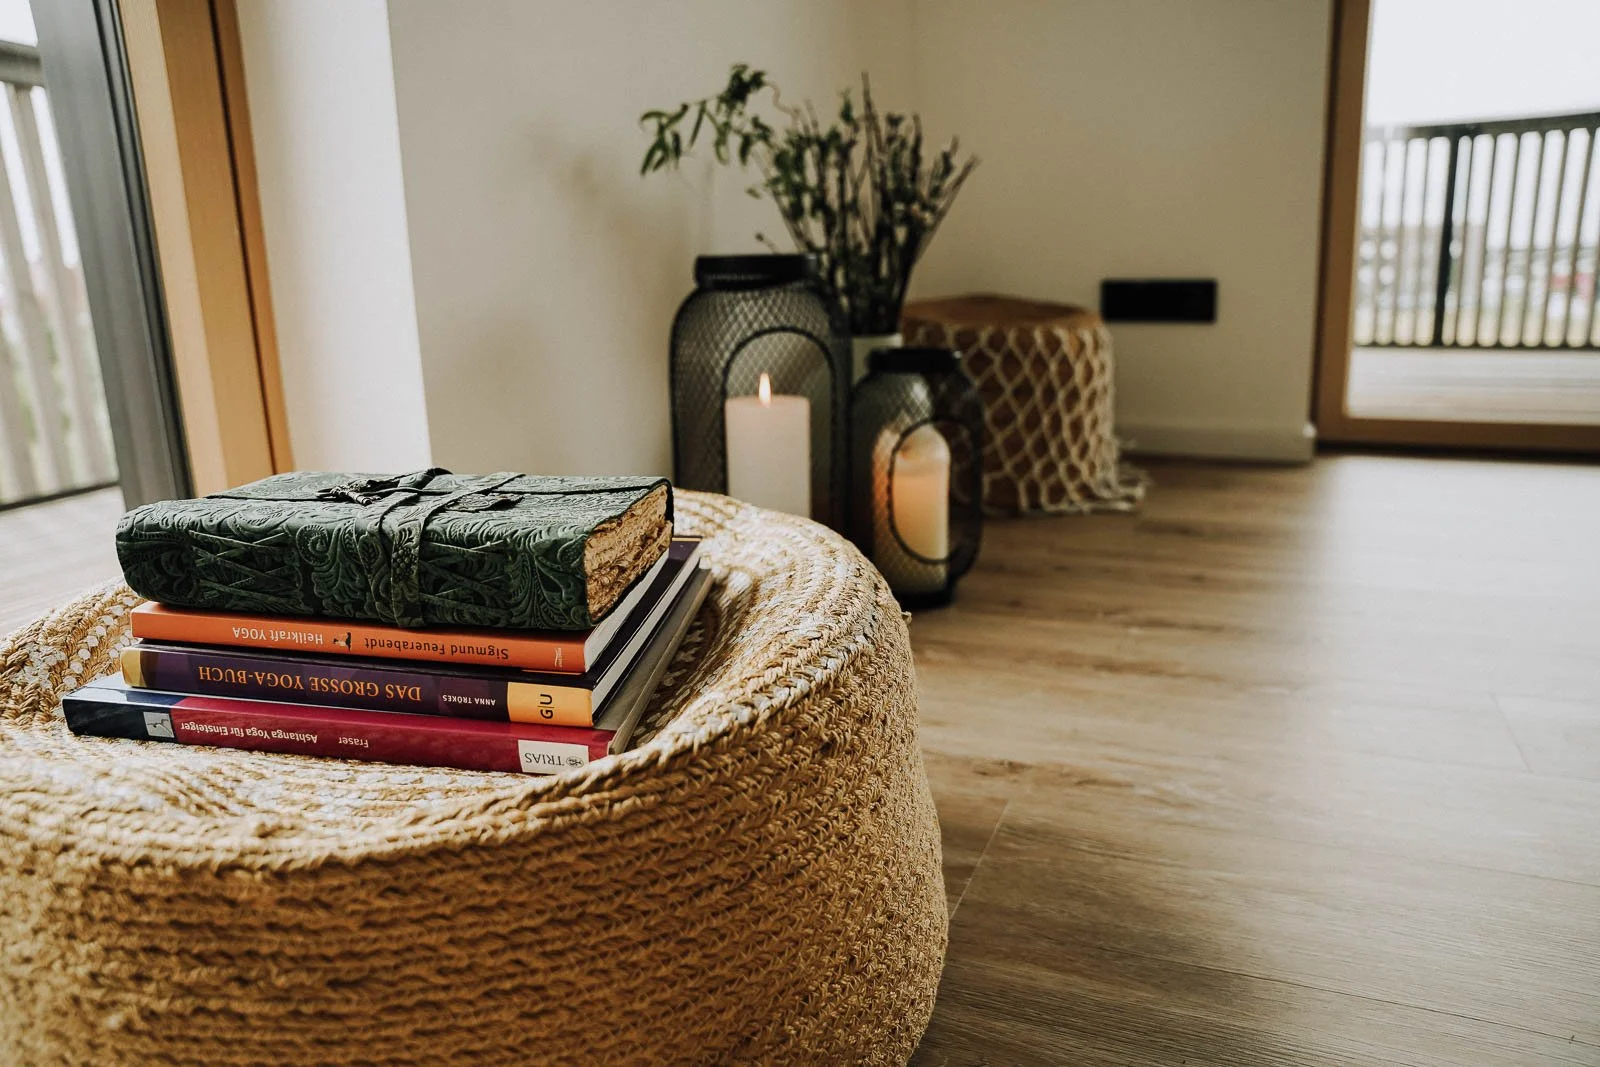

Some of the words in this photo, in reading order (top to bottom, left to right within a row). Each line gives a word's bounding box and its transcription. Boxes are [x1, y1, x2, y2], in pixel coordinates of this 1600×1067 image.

[232, 627, 265, 641] YOGA
[269, 629, 324, 645] Heilkraft
[364, 637, 446, 655] Feuerabendt
[450, 643, 509, 660] Sigmund
[198, 666, 305, 690] YOGA-BUCH
[310, 677, 379, 697] GROSSE
[385, 684, 422, 701] DAS
[180, 722, 229, 736] Einsteiger
[229, 725, 245, 737] für
[246, 727, 271, 739] Yoga
[270, 731, 318, 744] Ashtanga
[338, 737, 369, 748] Fraser
[524, 752, 563, 767] TRIAS
